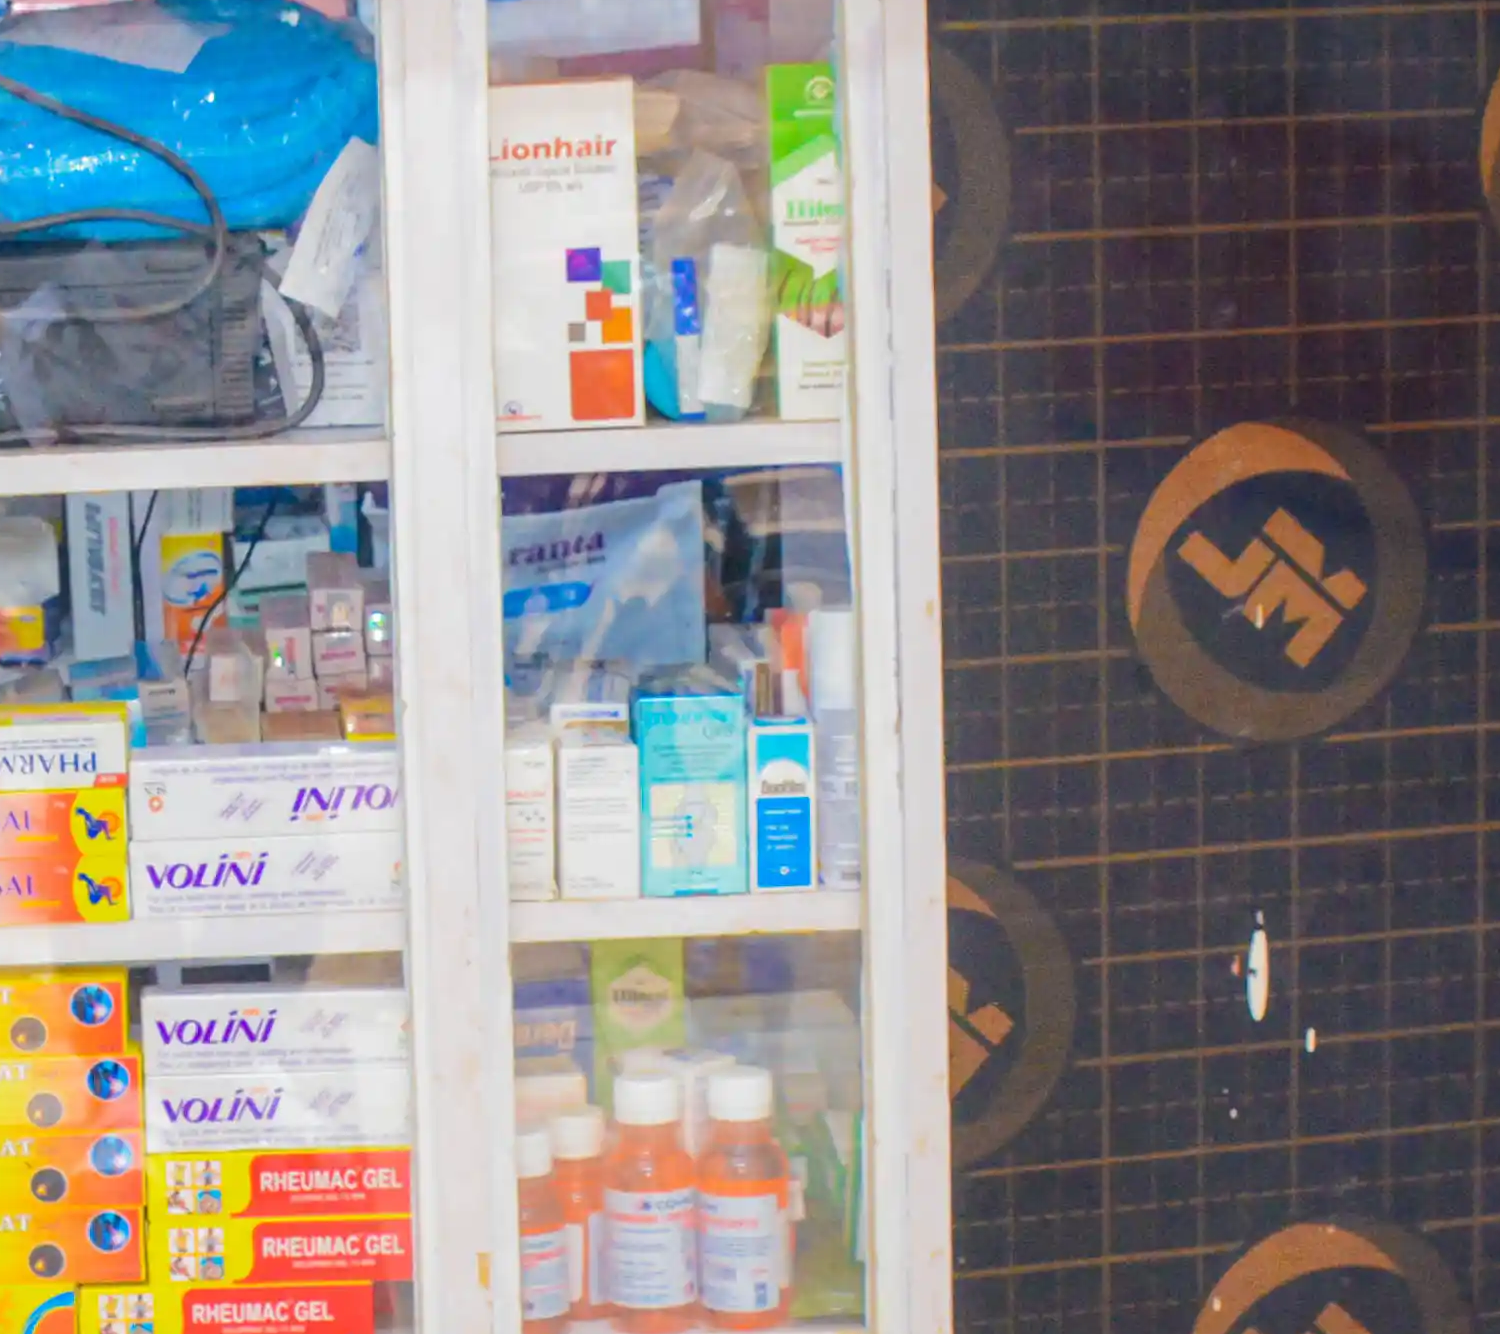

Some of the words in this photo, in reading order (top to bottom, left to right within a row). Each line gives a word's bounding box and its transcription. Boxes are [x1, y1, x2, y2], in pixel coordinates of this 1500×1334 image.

[258, 1168, 358, 1193] RHEUMAC
[363, 1165, 403, 1189] GEL
[261, 1236, 360, 1261] RHEUMAC
[366, 1233, 406, 1257] GEL
[190, 1302, 289, 1326] RHEUMAC
[293, 1299, 335, 1323] GEL
